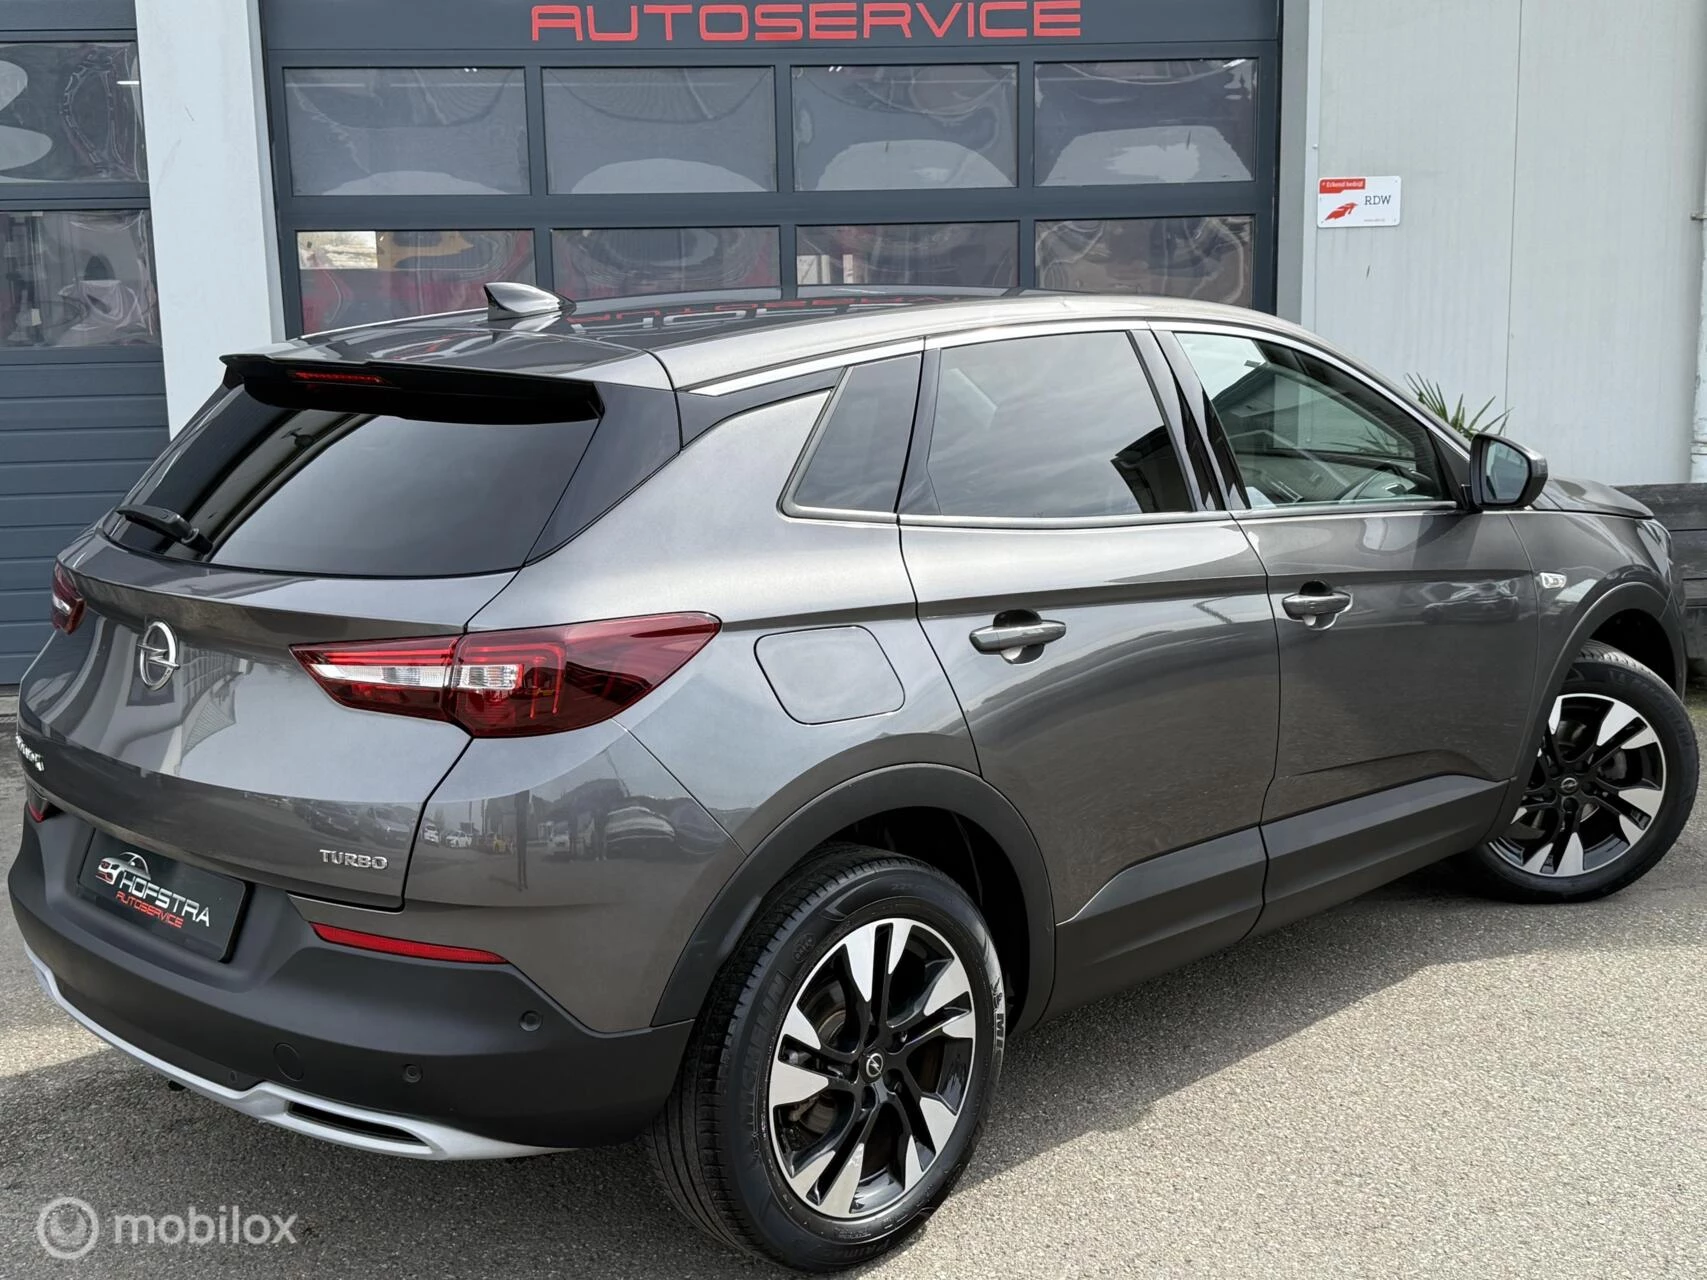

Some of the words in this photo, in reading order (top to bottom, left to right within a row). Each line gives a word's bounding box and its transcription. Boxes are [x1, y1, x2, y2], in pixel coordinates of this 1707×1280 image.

[530, 0, 1081, 41] AUTOSERVICE
[1364, 195, 1391, 205] RDW
[319, 849, 388, 869] TURBO
[115, 890, 185, 929] AUTOSERVICE
[119, 872, 210, 927] HOFSTRA
